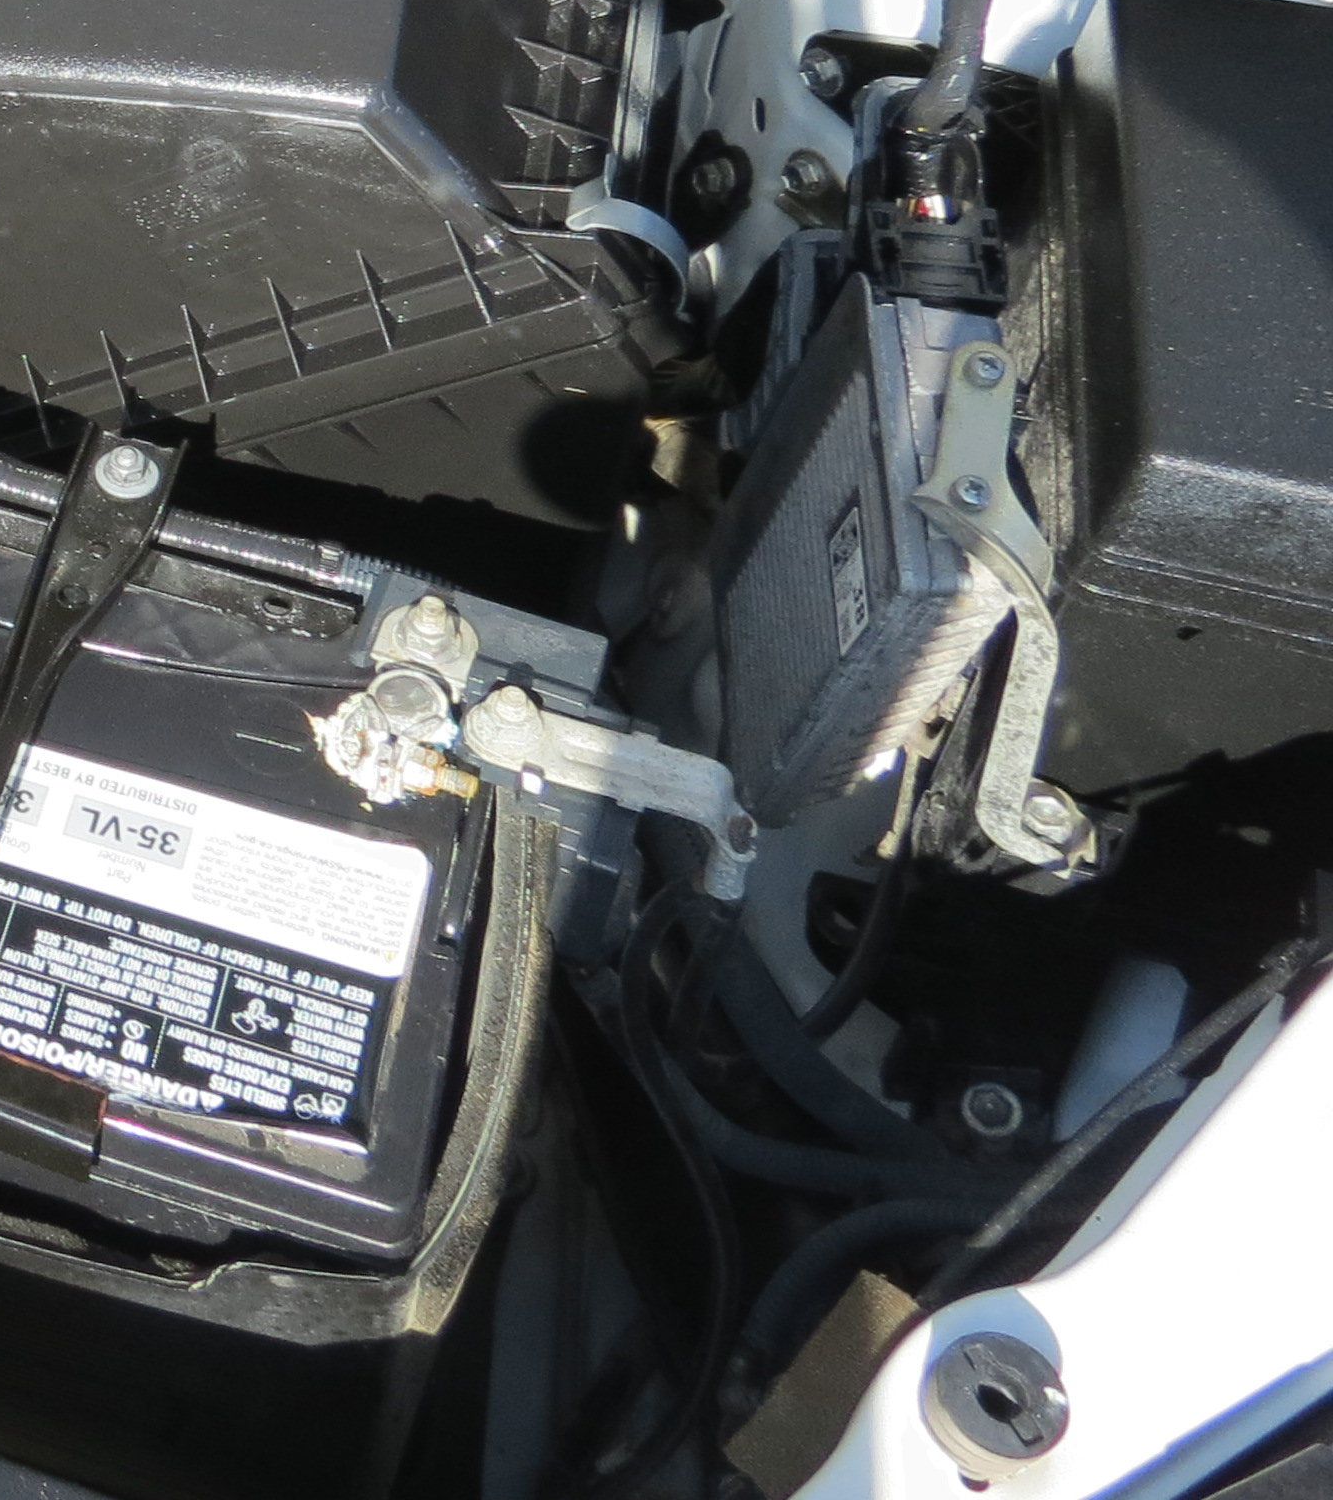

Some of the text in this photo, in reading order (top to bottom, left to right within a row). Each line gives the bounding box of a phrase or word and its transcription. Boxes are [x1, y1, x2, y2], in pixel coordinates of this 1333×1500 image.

[30, 757, 72, 780] BEST
[73, 769, 96, 787] BY
[97, 776, 199, 817] DISTRIBUTED
[73, 804, 183, 858] 35-VL
[95, 848, 148, 873] Number
[104, 865, 133, 884] Part
[17, 884, 44, 905] NOT
[41, 892, 61, 910] DO
[60, 897, 86, 918] TIP.
[84, 905, 113, 926] NOT
[111, 913, 133, 932] DO
[32, 927, 63, 948] SEEK
[133, 919, 202, 954] CHILDREN.
[320, 931, 381, 956] WARNING
[0, 945, 47, 972] FOLLOW
[103, 934, 220, 982] SERVICE ASSISTANCE.
[199, 940, 221, 959] OF
[218, 945, 264, 973] REACH
[76, 956, 121, 980] VEHICLE
[118, 954, 143, 973] NOT
[141, 961, 156, 977] IF
[153, 964, 171, 982] OR
[262, 959, 292, 981] THE
[13, 973, 58, 1000] SEVERE
[98, 976, 131, 999] JUMP
[120, 969, 136, 985] IN
[167, 969, 216, 996] MANUAL
[290, 967, 313, 987] OF
[311, 973, 340, 996] OUT
[129, 986, 154, 1007] FOR
[134, 973, 212, 1009] INSTRUCTIONS
[230, 973, 370, 1028] GET MEDICAL HELP FAST.
[338, 982, 375, 1007] KEEP
[63, 990, 115, 1019] SMOKING
[61, 1006, 110, 1034] FLAMES
[332, 1019, 366, 1042] WITH
[57, 1021, 106, 1050] SPARKS
[283, 1020, 363, 1057] IMMEDIATELY
[117, 1037, 150, 1065] NO
[165, 1022, 355, 1094] CAN CAUSE BLINDNESS OR INJURY
[288, 1037, 360, 1071] FLUSH EYES
[179, 1044, 293, 1095] EXPLOSIVE GASES
[206, 1072, 288, 1113] SHIELD EYES
